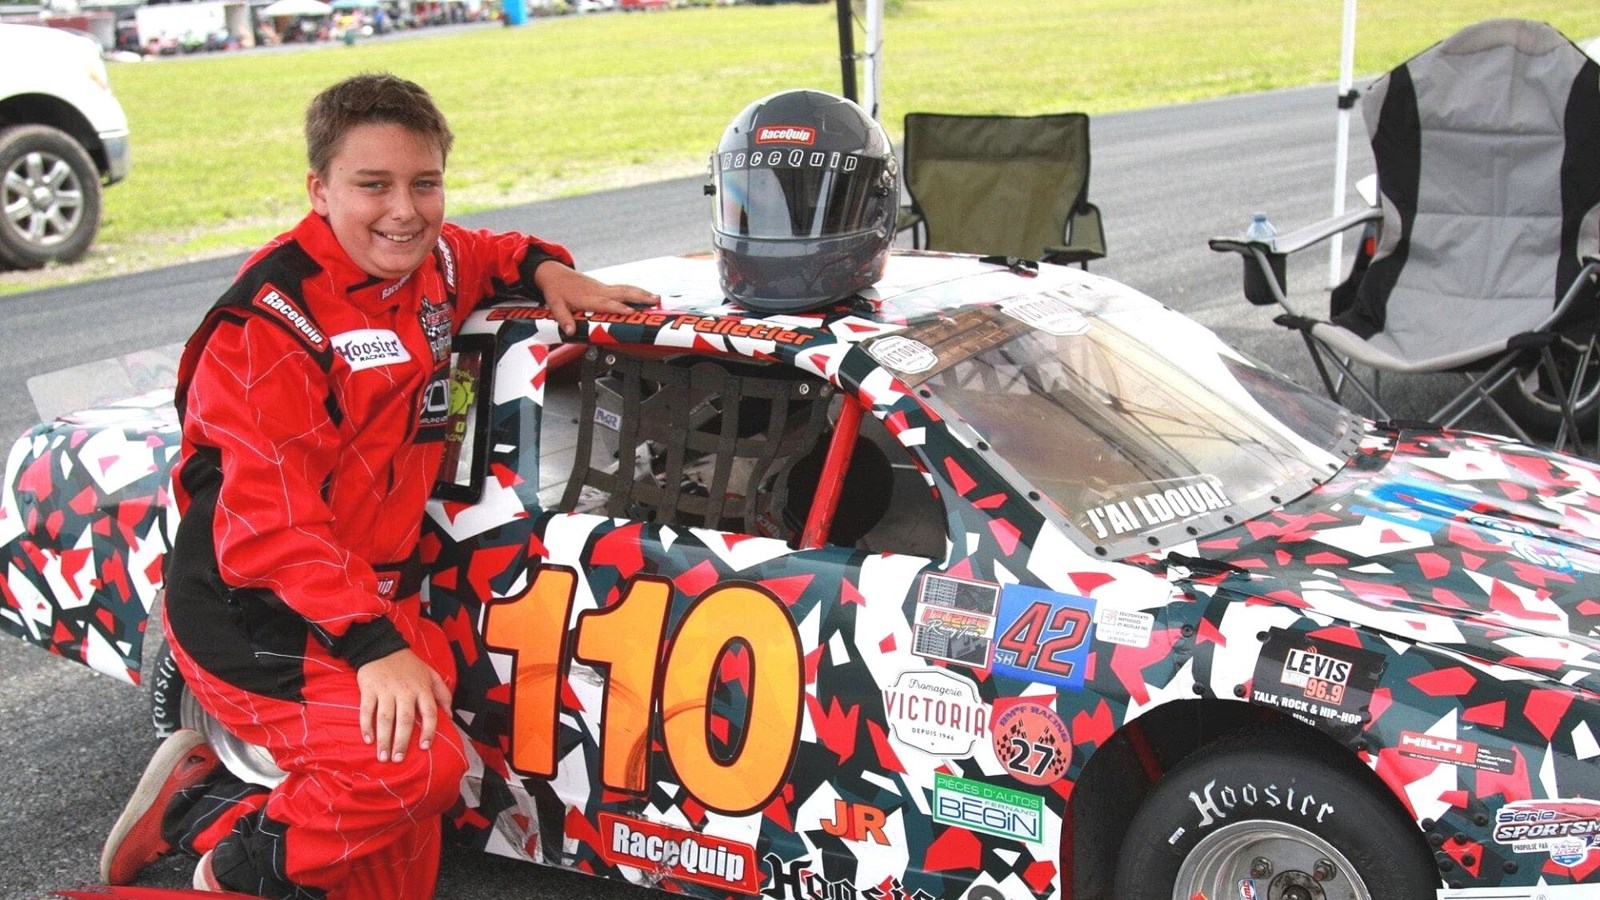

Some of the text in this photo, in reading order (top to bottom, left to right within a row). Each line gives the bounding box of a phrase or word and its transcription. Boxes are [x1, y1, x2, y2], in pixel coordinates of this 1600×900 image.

[760, 127, 811, 141] RaceQuip
[722, 149, 858, 172] RaceQuip
[670, 314, 815, 345] Pelletier
[334, 336, 399, 361] Hoosier
[360, 353, 386, 362] RACING
[1087, 501, 1142, 539] J'AI
[996, 600, 1092, 679] 42
[1286, 650, 1349, 683] LEVIS
[482, 562, 806, 818] 110
[908, 679, 963, 697] Fromagerie
[1305, 678, 1343, 703] 96.9
[884, 689, 986, 739] VICTORIA
[1254, 690, 1362, 725] TALK, ROCK & HIP-HOP
[911, 727, 937, 738] DEPUIS
[1030, 706, 1069, 743] RACING
[1008, 736, 1055, 778] 27
[1402, 735, 1462, 755] HILTI
[983, 788, 1040, 809] D'AUTOS
[984, 801, 1037, 817] FERNAND
[1188, 778, 1335, 827] Hoosier
[819, 799, 892, 846] JR
[612, 822, 745, 882] RaceQuip
